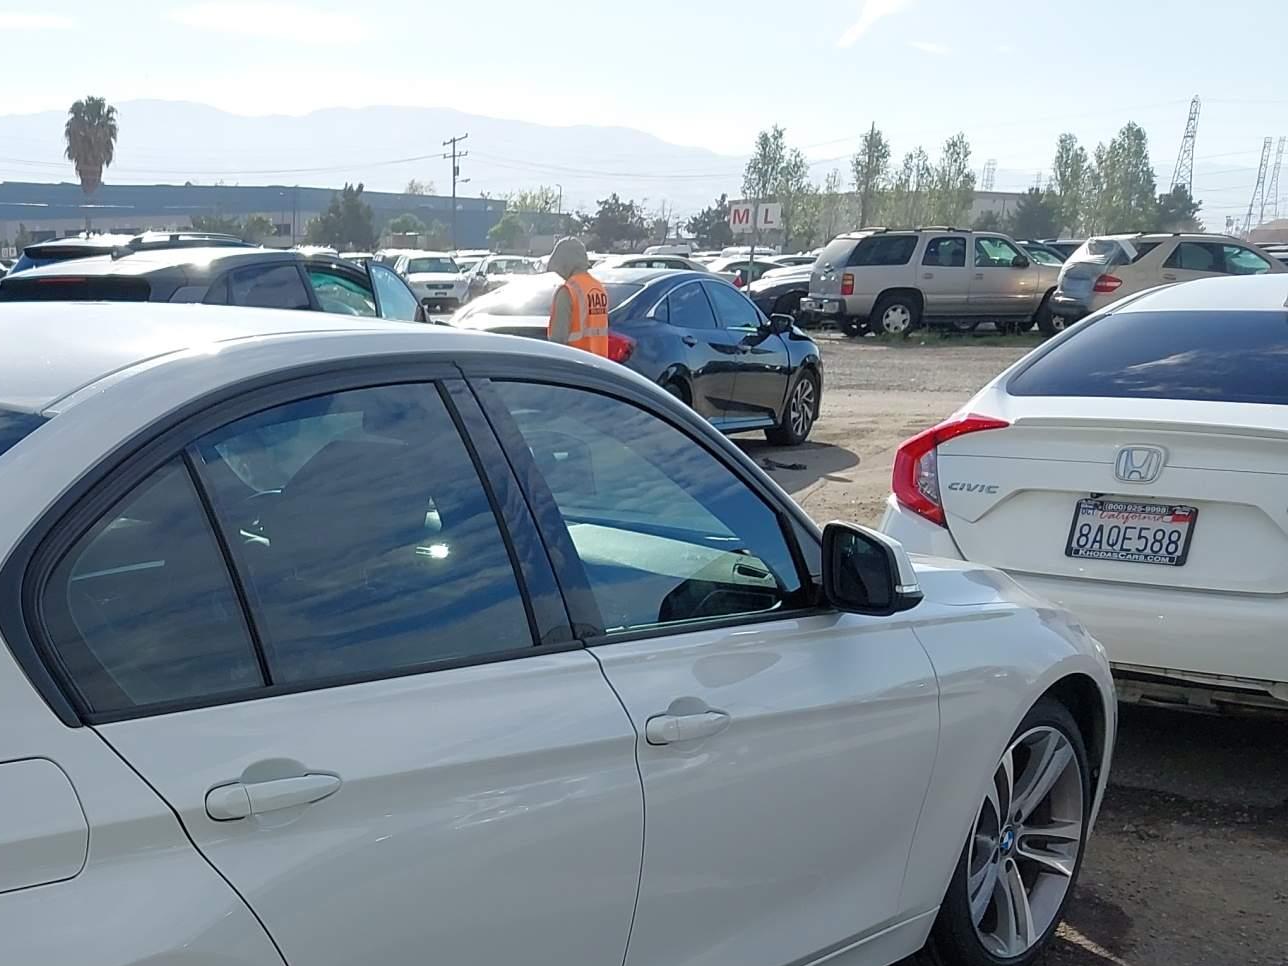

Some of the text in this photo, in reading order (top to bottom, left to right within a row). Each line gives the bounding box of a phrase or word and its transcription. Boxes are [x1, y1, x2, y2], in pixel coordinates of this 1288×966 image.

[733, 207, 774, 224] M L
[948, 482, 1000, 494] CIVIC
[1077, 523, 1182, 555] 8AQE588
